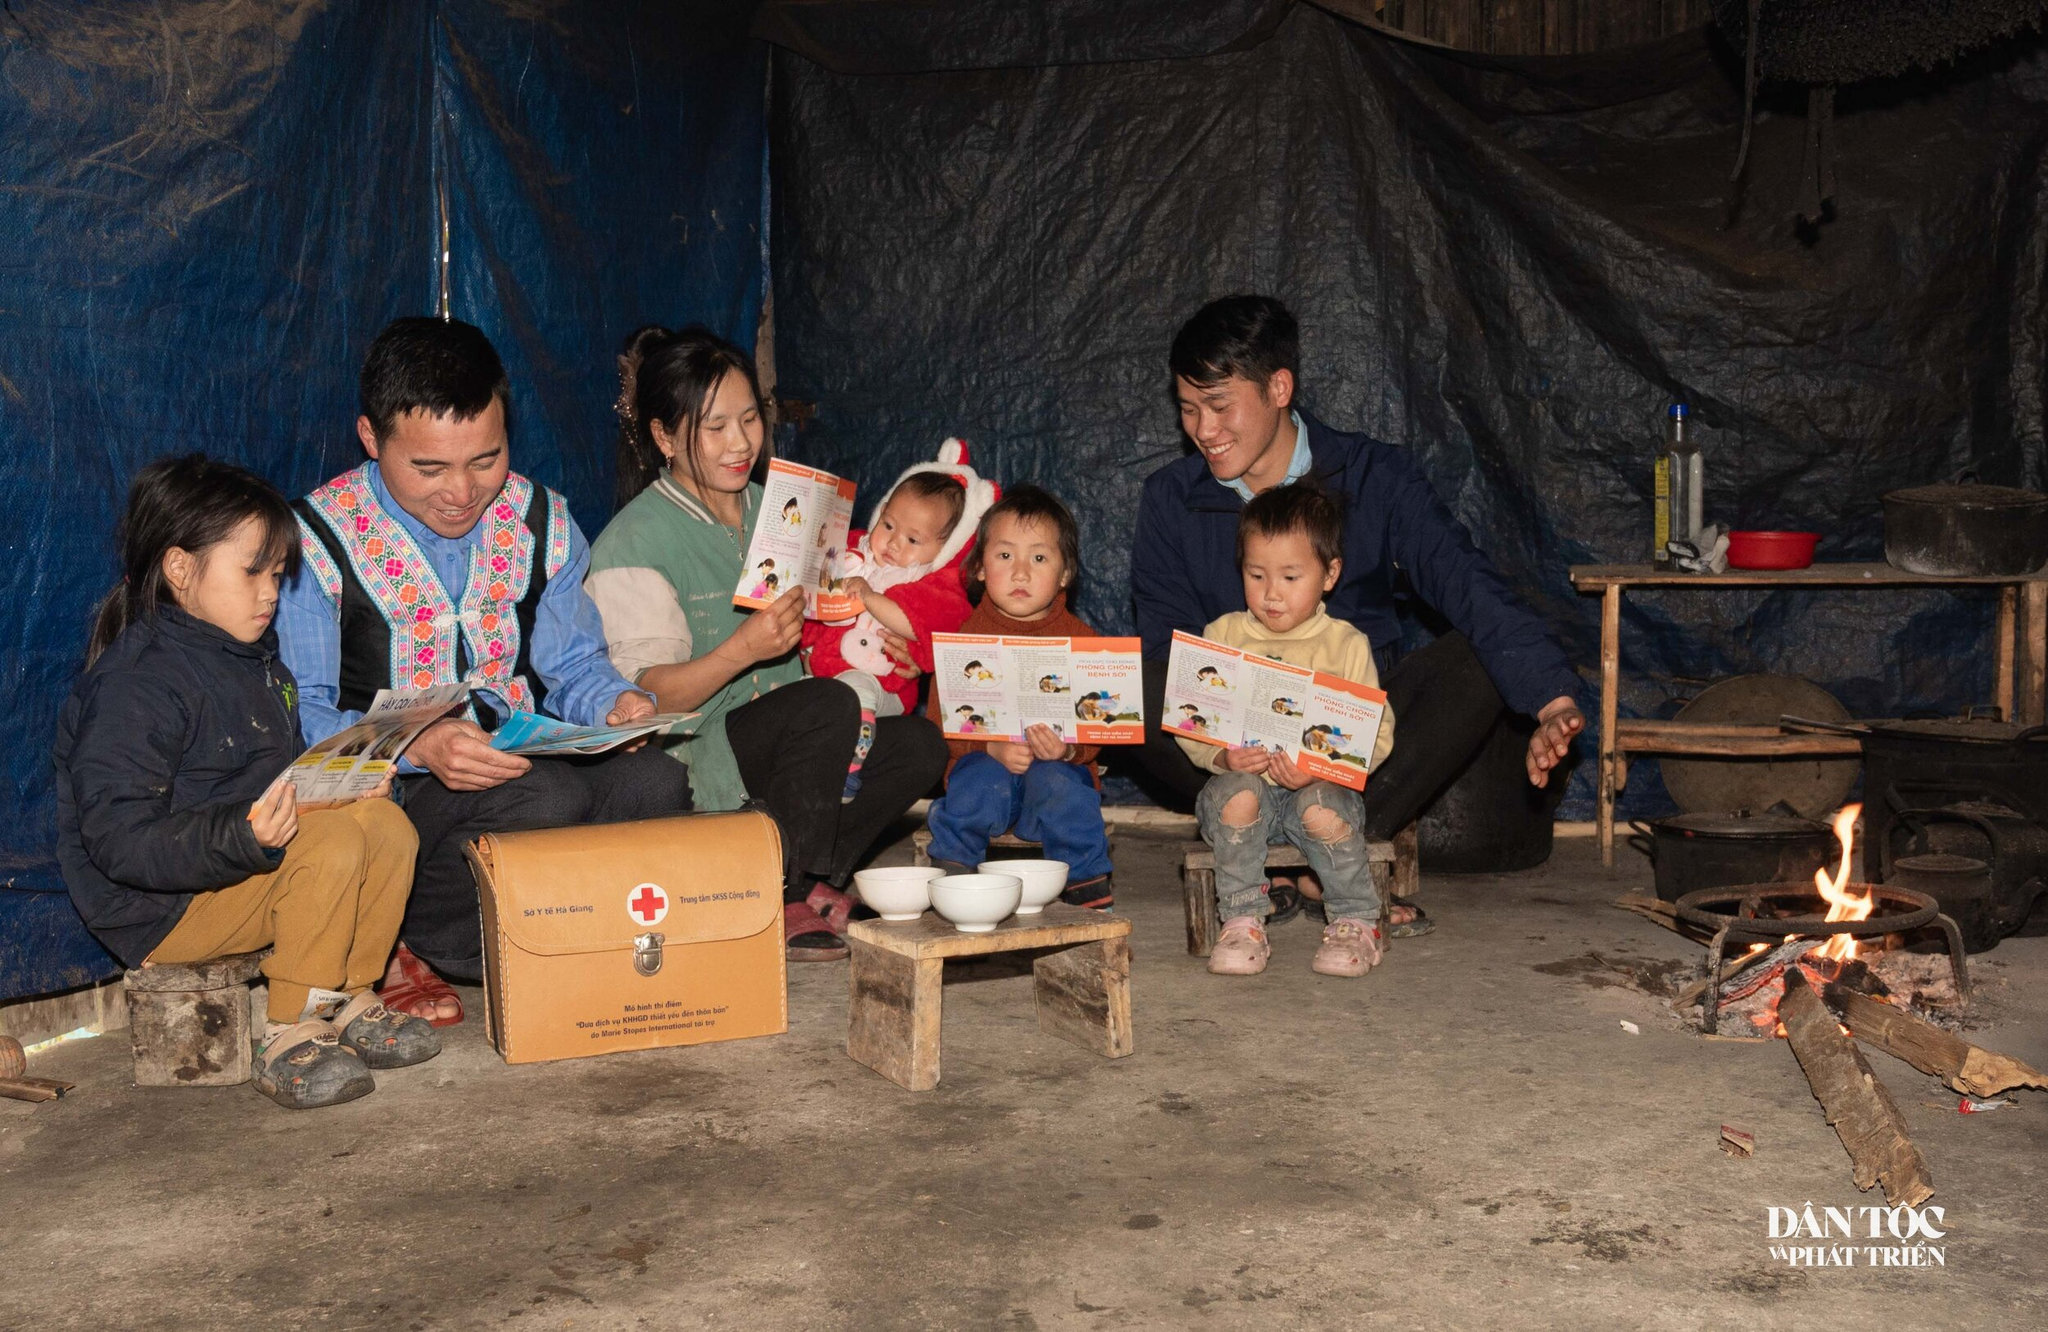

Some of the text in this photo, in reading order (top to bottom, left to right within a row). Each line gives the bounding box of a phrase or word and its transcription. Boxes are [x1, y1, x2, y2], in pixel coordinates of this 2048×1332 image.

[680, 896, 698, 904] Trung
[712, 892, 728, 901] SKSS
[569, 905, 594, 913] Giang
[601, 1029, 621, 1037] Marie
[623, 1027, 647, 1035] Stopes
[648, 1021, 692, 1032] International
